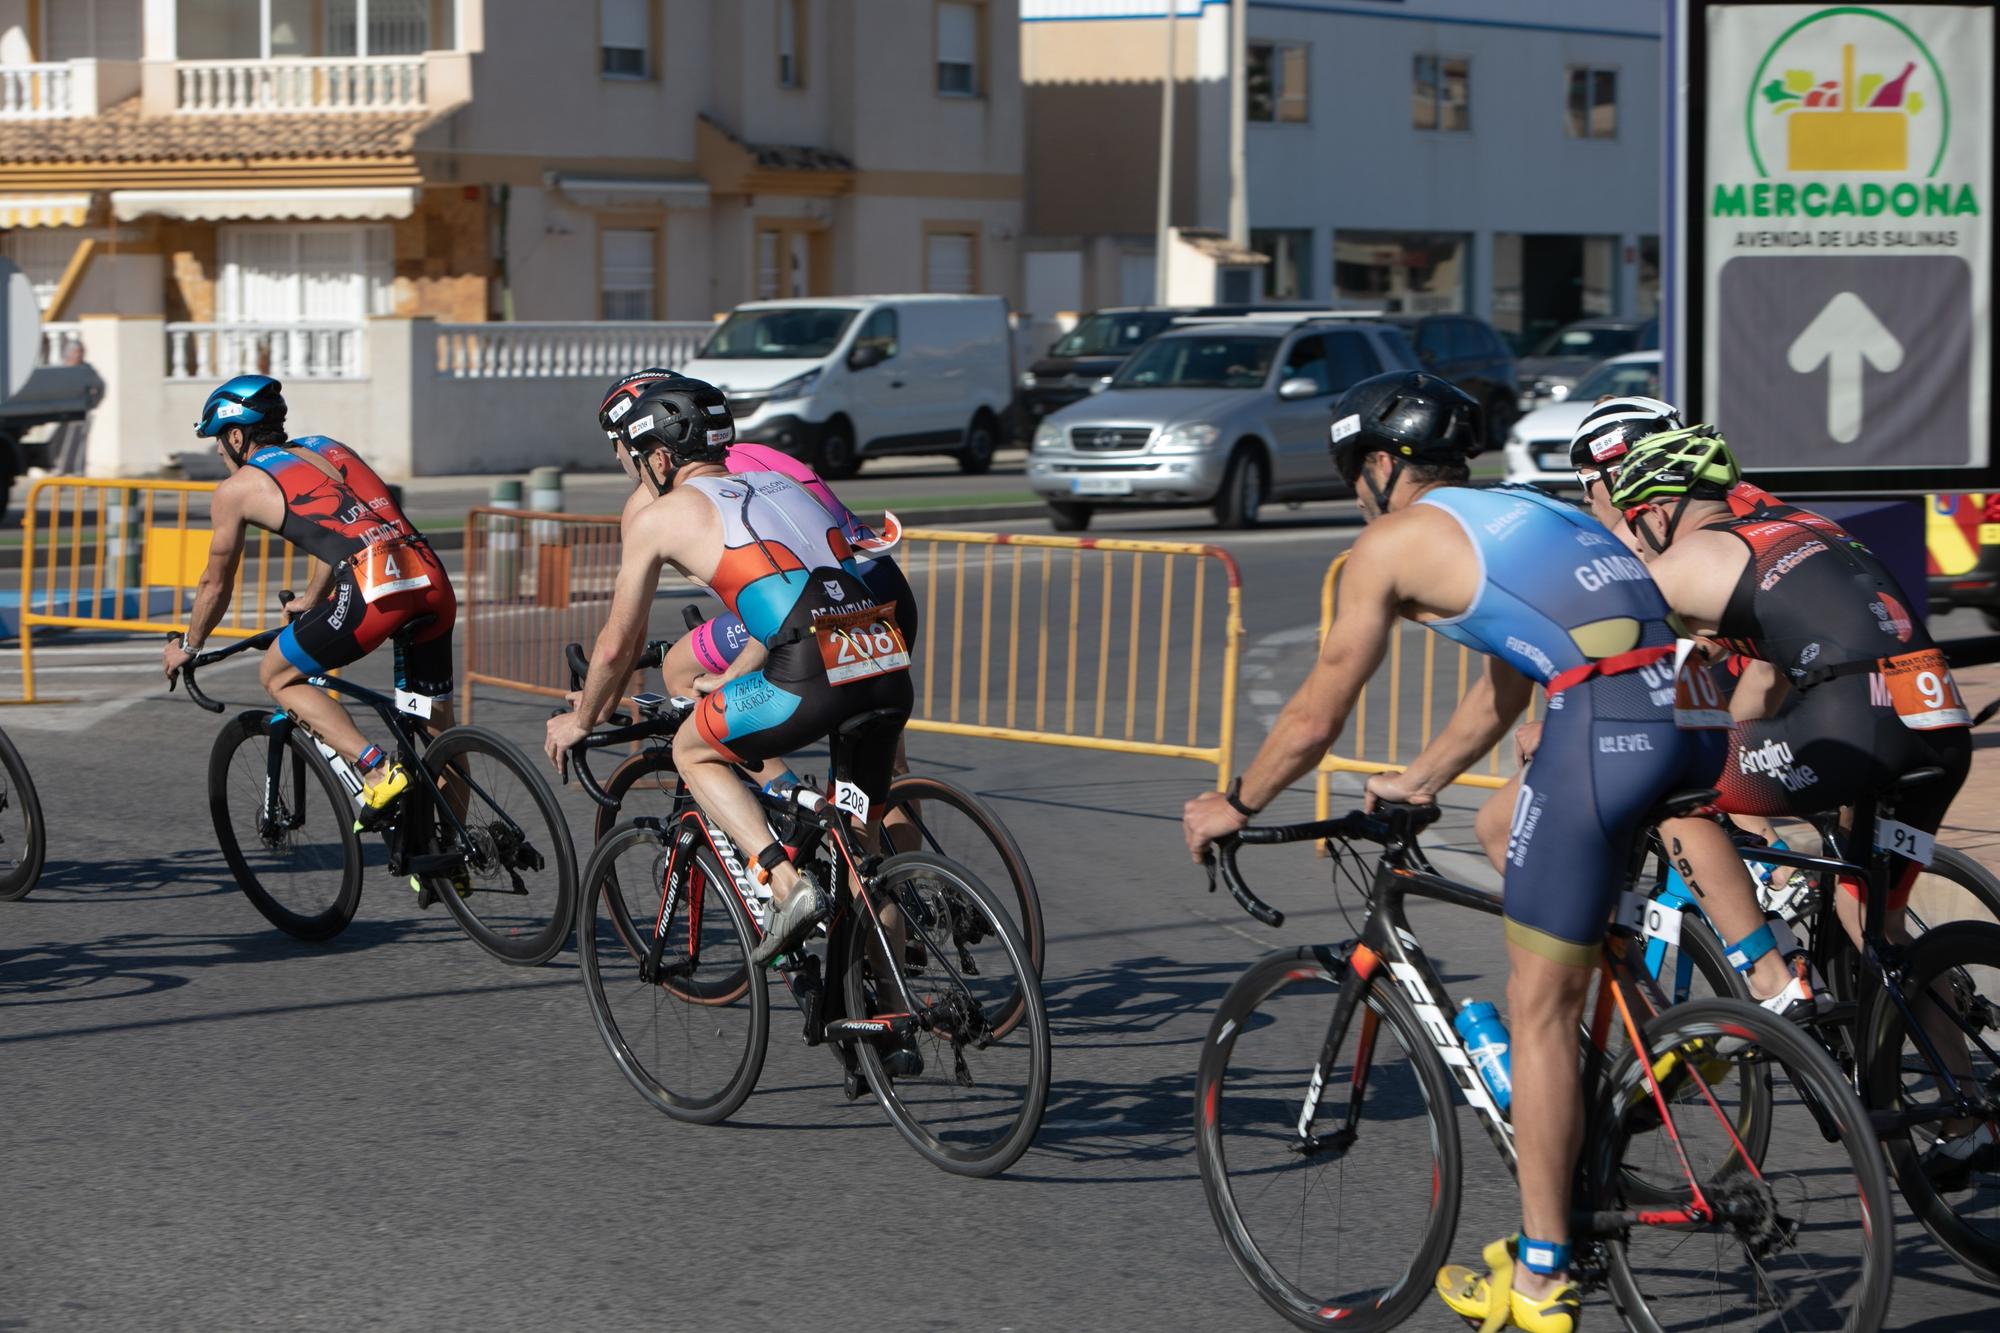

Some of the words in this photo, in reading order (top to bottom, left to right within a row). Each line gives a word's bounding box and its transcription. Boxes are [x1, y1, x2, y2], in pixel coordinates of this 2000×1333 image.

[1713, 183, 1980, 217] MERCADONA
[1735, 231, 1813, 247] AVENIDA
[1818, 231, 1841, 247] DE
[1847, 231, 1878, 247] LAS
[1883, 231, 1959, 247] SALINAS
[385, 554, 401, 579] 4
[831, 622, 894, 664] 208
[407, 698, 418, 711] 4
[1776, 764, 1819, 792] bike
[840, 787, 865, 815] 208
[1894, 828, 1917, 856] 91
